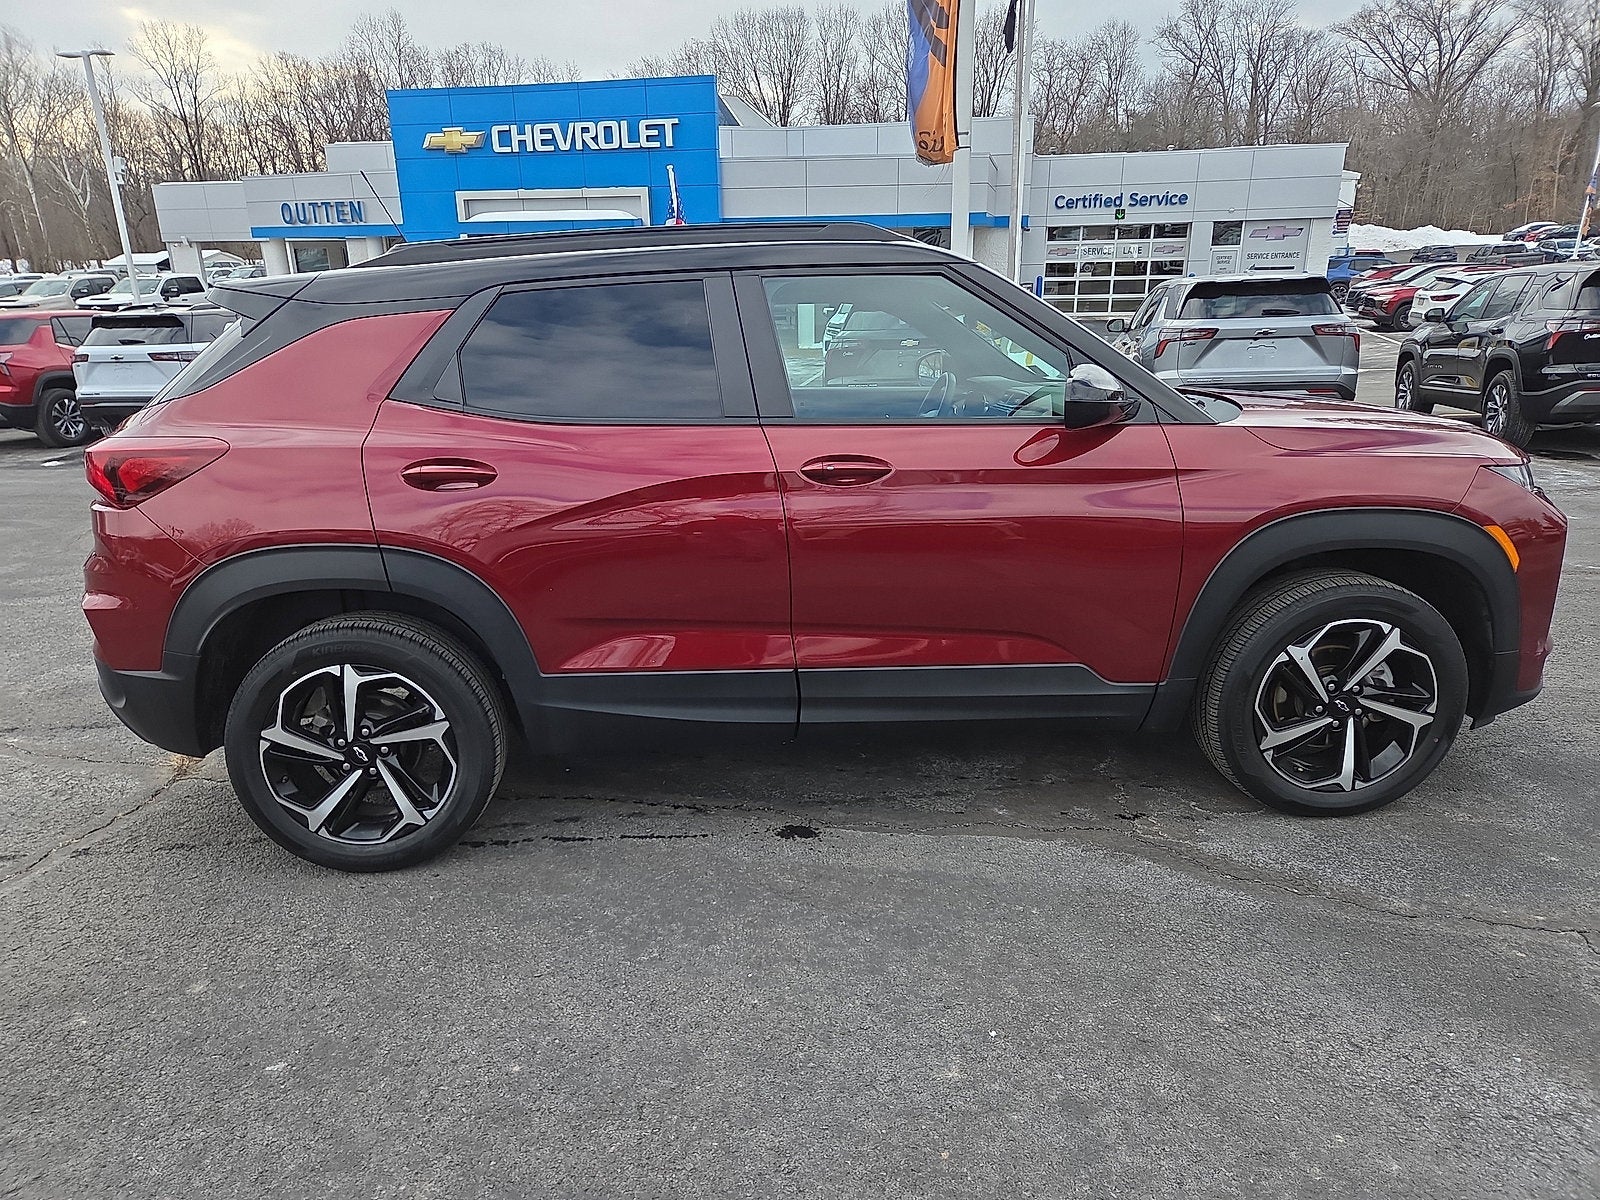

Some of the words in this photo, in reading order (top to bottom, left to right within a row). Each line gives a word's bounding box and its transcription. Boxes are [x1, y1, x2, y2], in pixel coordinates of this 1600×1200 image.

[491, 118, 680, 153] CHEVROLET
[1054, 192, 1124, 210] Certified
[1128, 190, 1189, 208] Service
[280, 200, 366, 226] OUTTEN
[1082, 246, 1113, 256] SERVICE
[1122, 246, 1143, 255] LANE
[1246, 252, 1270, 260] SERVICE
[1270, 251, 1301, 259] ENTRANCE
